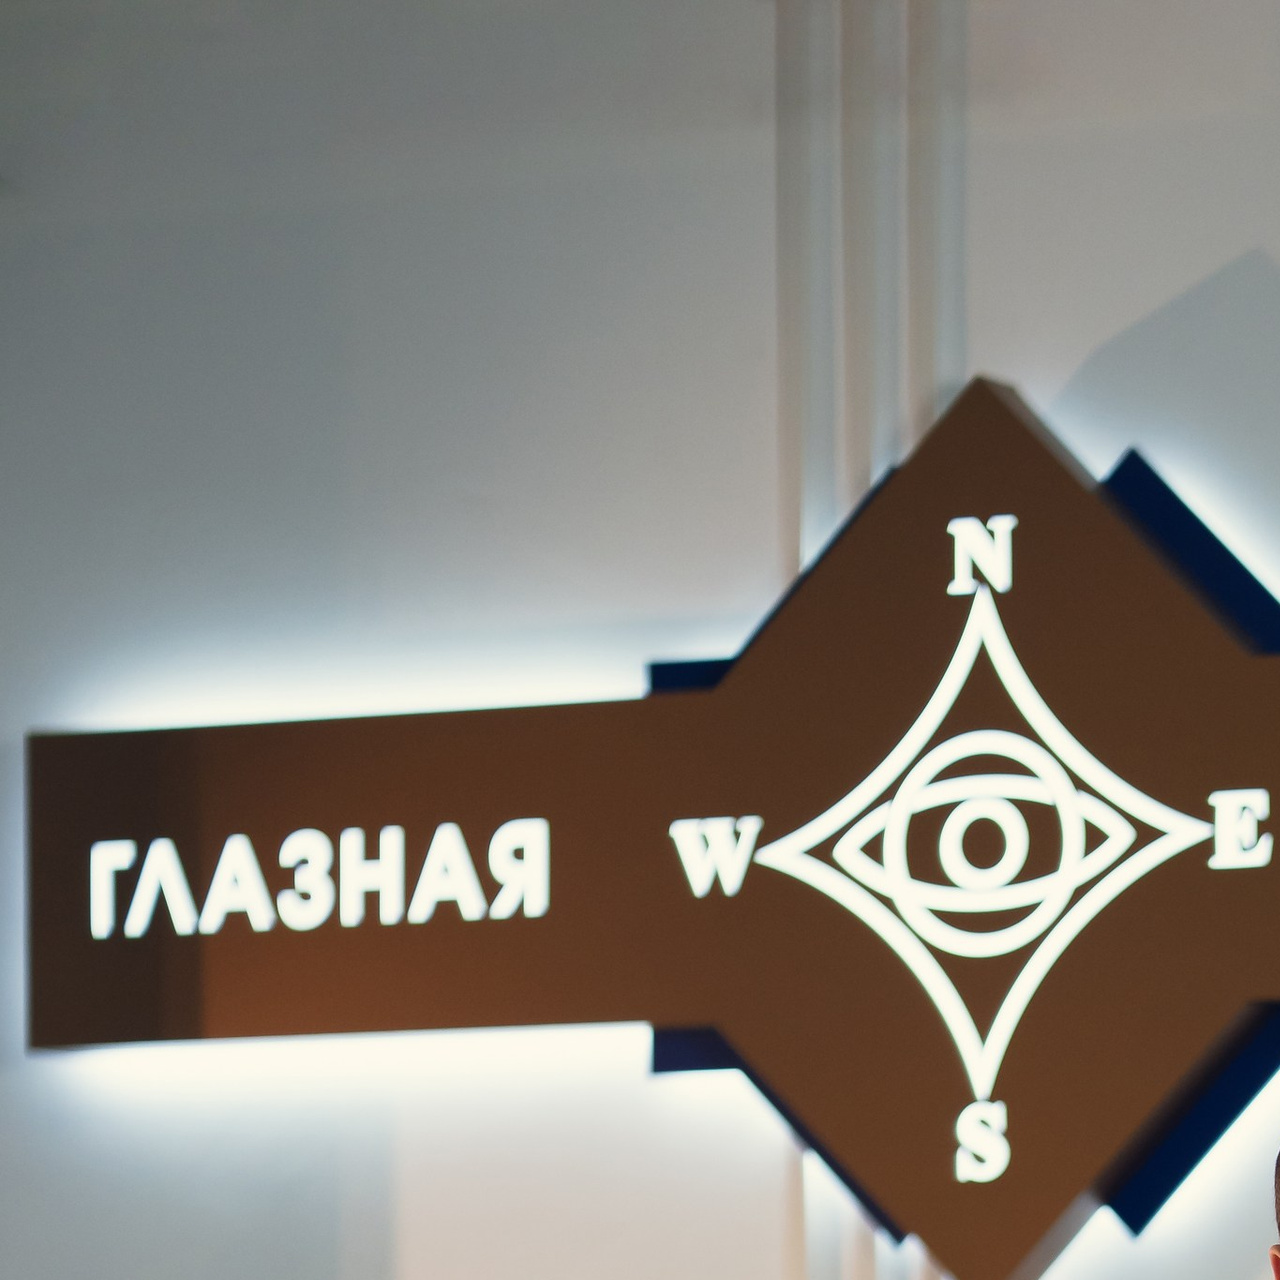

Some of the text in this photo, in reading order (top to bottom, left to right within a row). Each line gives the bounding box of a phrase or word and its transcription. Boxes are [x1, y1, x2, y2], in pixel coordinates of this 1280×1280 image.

[947, 514, 1018, 595] N
[668, 815, 764, 899] W
[1207, 788, 1274, 870] E
[89, 817, 551, 940] ГЛАЗНАЯ
[954, 1100, 1011, 1183] S
